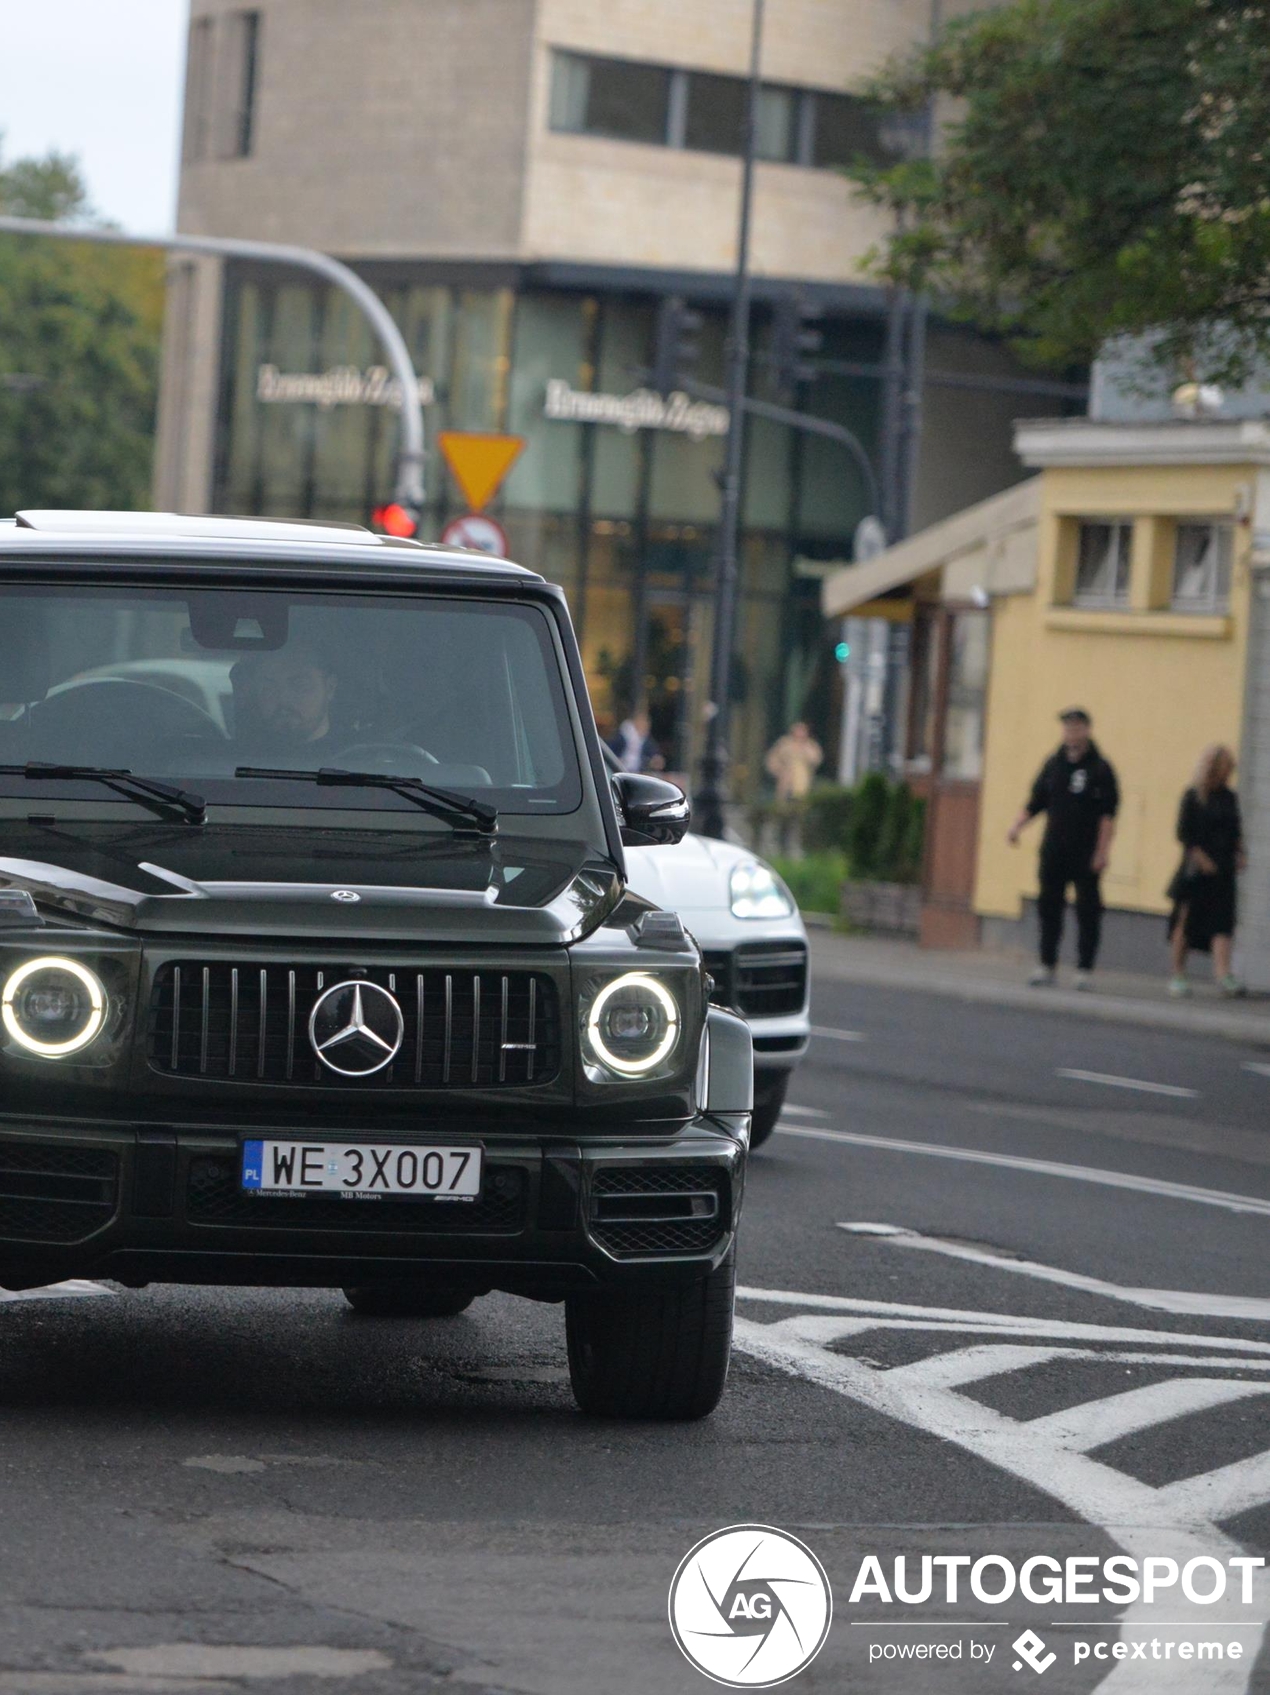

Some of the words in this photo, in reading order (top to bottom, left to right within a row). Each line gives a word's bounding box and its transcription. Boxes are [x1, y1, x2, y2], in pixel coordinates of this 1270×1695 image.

[273, 1145, 325, 1186] WE
[342, 1148, 471, 1191] 3X007
[245, 1169, 260, 1181] PL
[256, 1190, 307, 1198] Mercedes-Benz
[340, 1191, 354, 1199] MB
[356, 1192, 382, 1200] Motors
